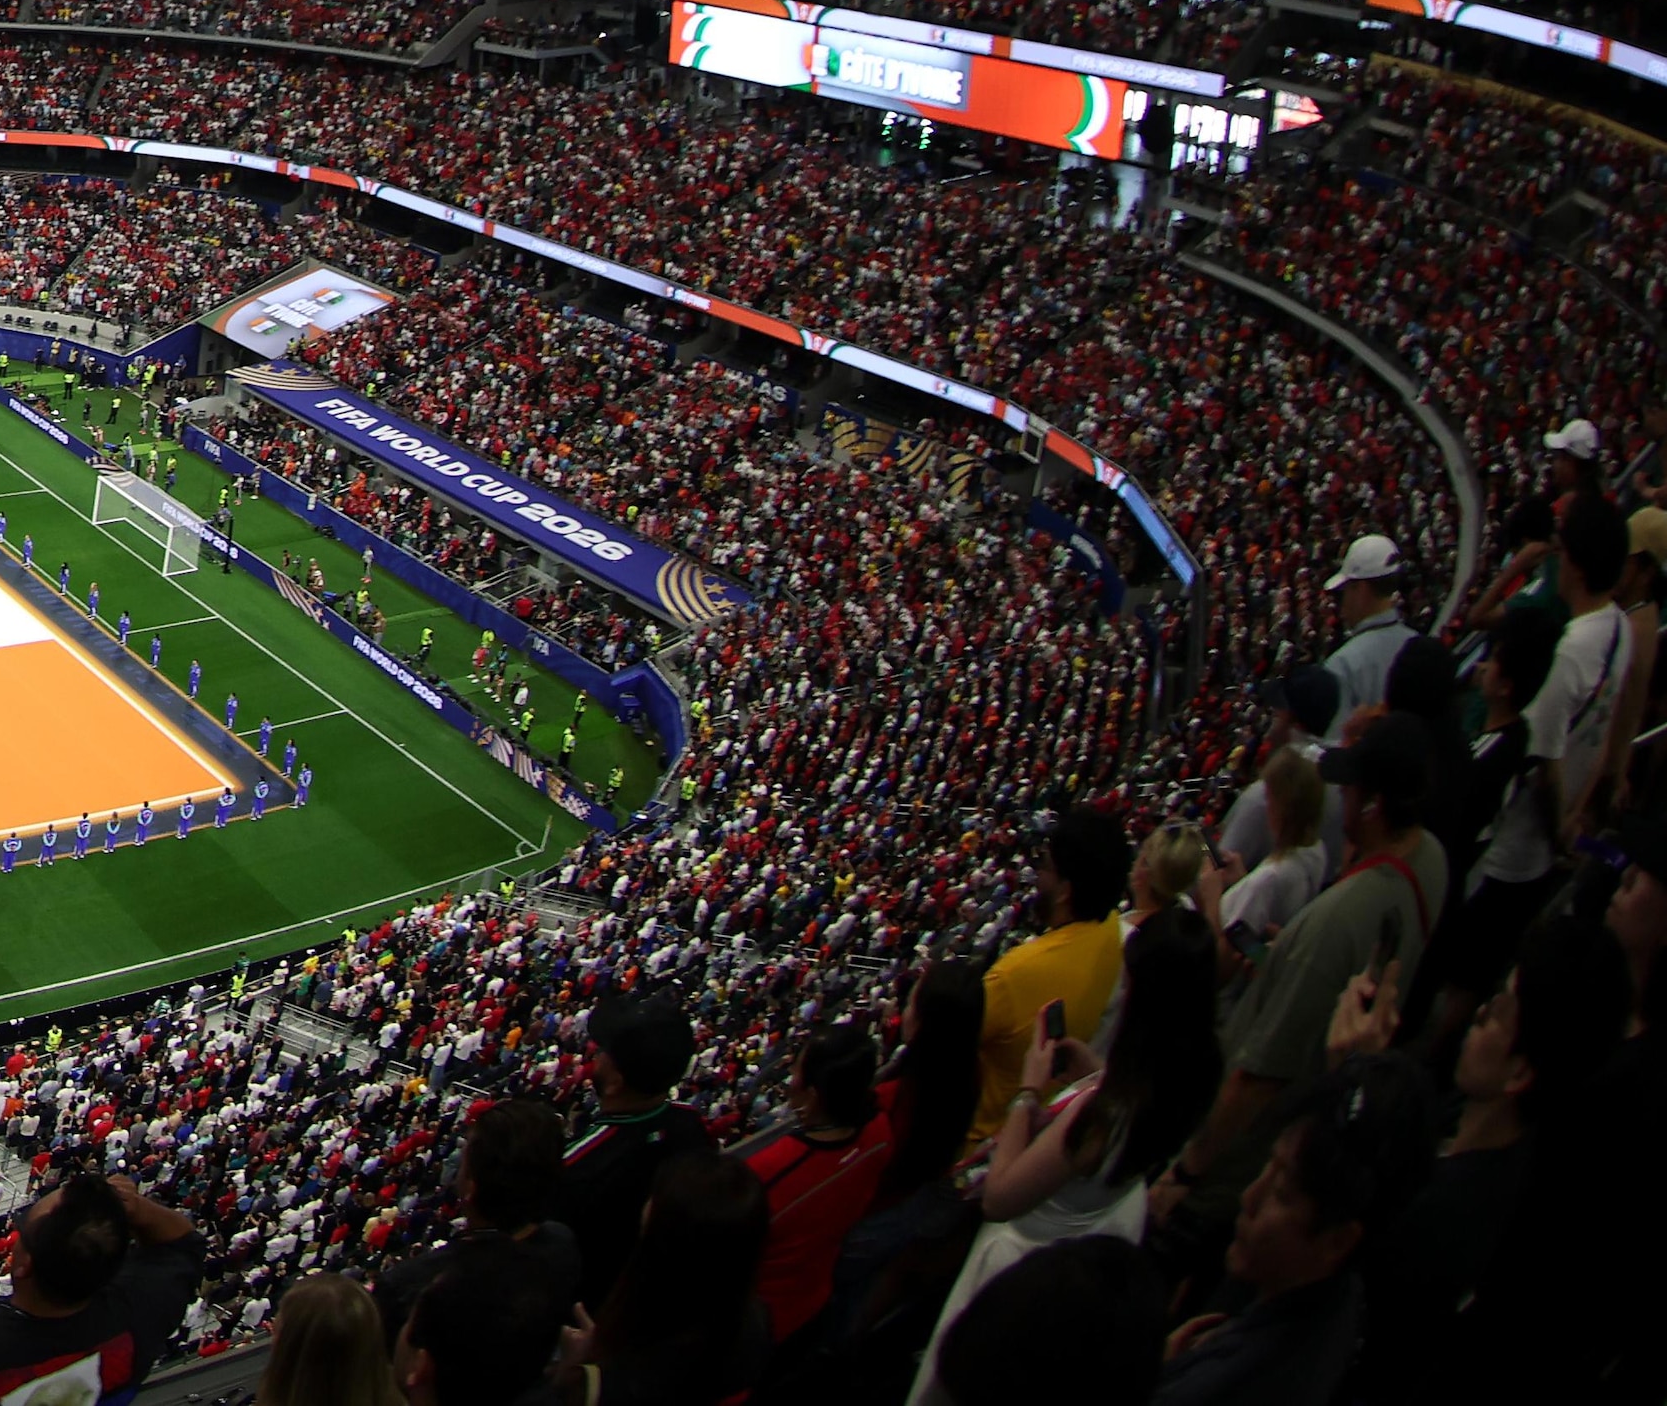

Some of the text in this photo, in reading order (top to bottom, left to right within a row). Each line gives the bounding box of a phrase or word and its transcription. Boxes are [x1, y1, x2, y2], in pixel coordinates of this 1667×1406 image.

[839, 48, 885, 89] CÔTE
[9, 398, 69, 445] FIFA WORLD CUP 2026
[204, 440, 221, 458] FIFA
[314, 398, 633, 562] FIFA WORLD CUP 2026
[352, 634, 443, 710] FIFA WORLD CUP 2026
